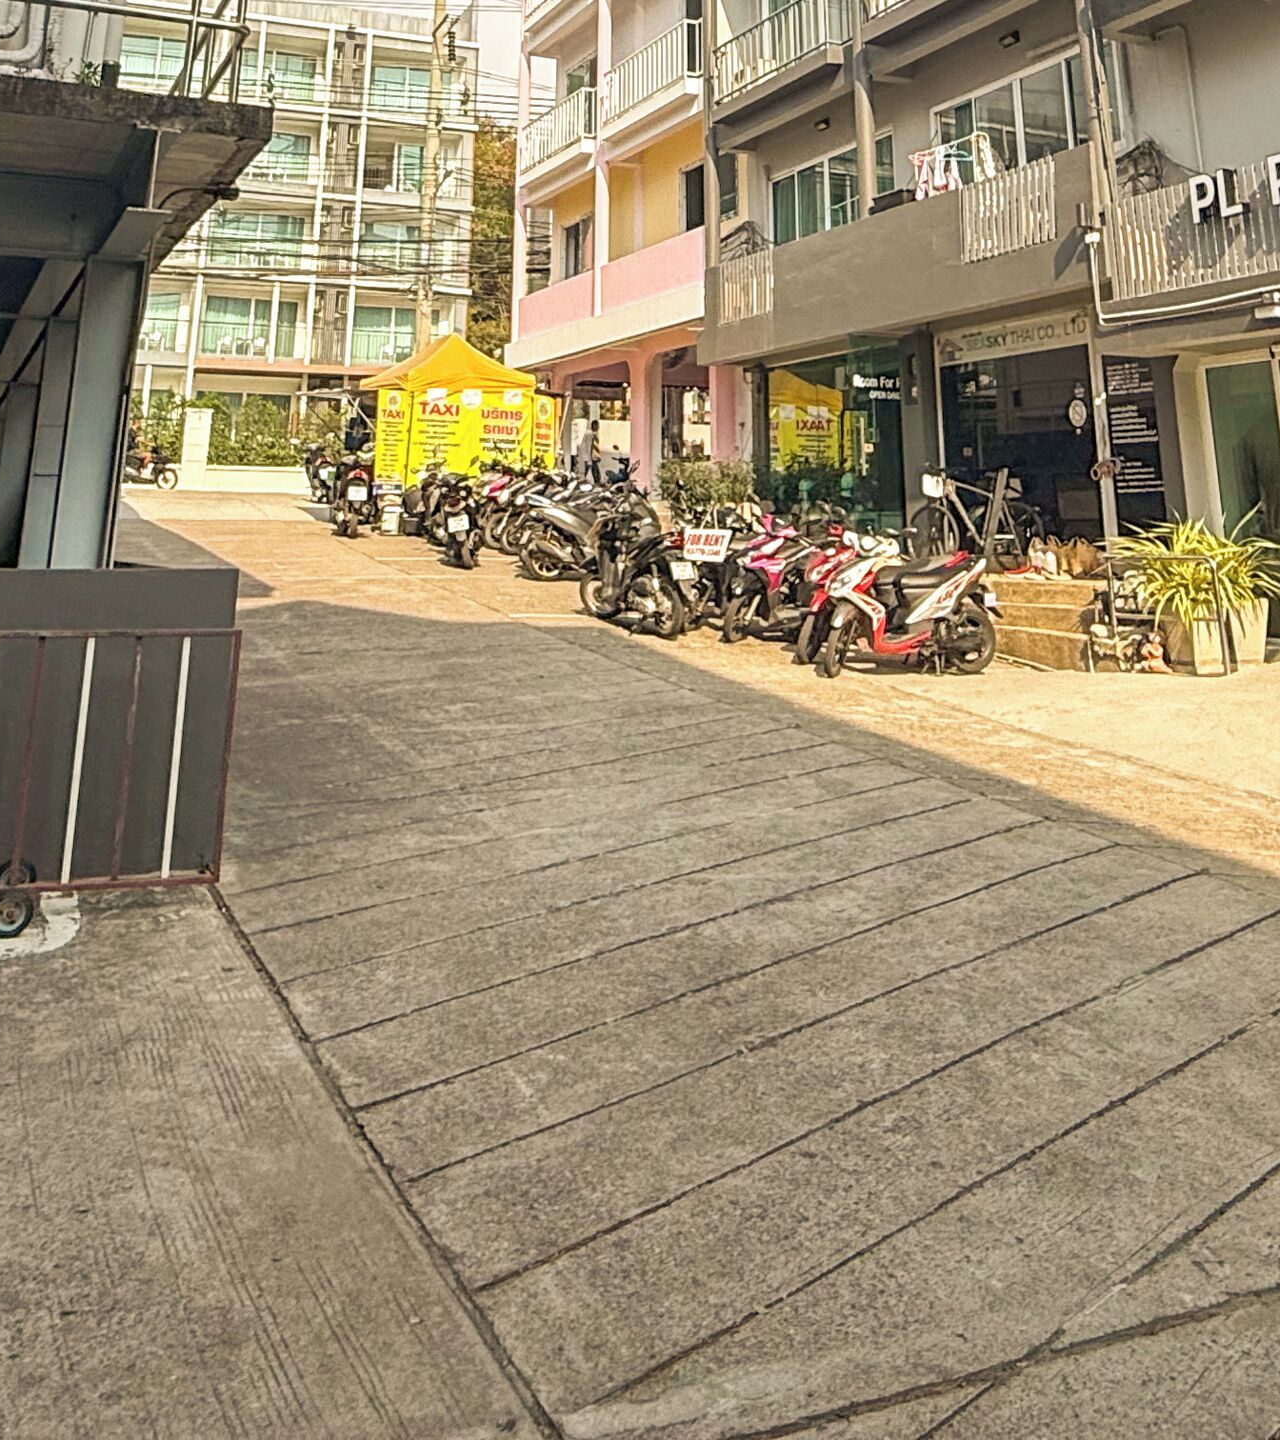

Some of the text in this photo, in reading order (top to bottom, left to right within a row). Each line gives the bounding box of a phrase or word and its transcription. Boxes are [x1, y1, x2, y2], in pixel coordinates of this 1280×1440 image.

[1188, 169, 1244, 225] PL
[852, 373, 879, 388] Room
[879, 375, 895, 389] For
[381, 409, 405, 420] TAXI
[418, 401, 460, 417] TAXI
[481, 406, 523, 421] บริการ
[684, 534, 702, 545] FOR
